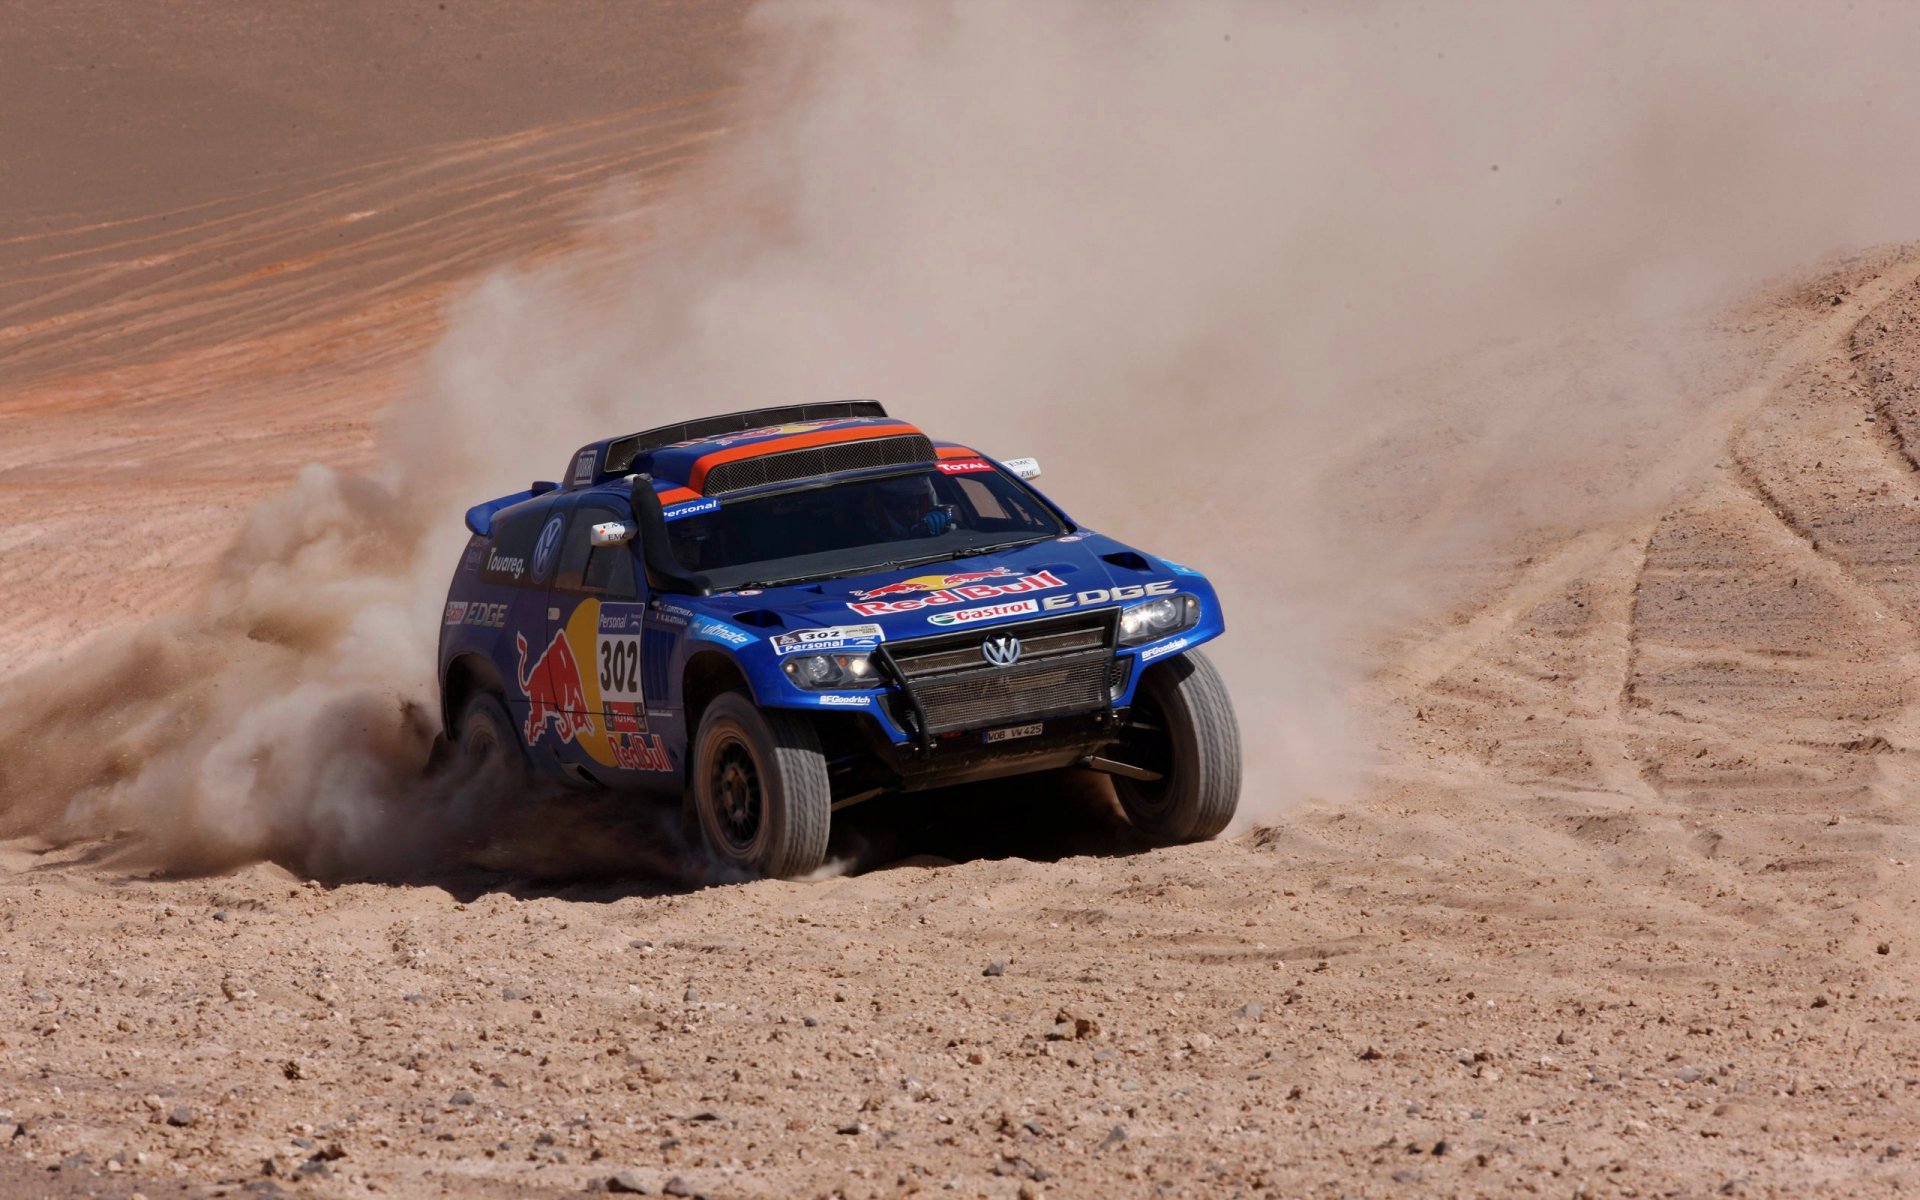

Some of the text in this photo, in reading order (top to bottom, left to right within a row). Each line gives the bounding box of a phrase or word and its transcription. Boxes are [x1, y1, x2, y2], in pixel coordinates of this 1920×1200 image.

[938, 462, 990, 471] TOTAL
[847, 570, 1068, 617] Red Bull
[1042, 580, 1179, 610] EDGE
[463, 602, 509, 628] EDGE
[955, 602, 1033, 621] Castrol
[600, 613, 627, 629] Personal
[805, 631, 840, 640] 302
[785, 639, 844, 652] Personal
[600, 640, 638, 693] 302
[819, 695, 870, 705] BFGoodrich
[1024, 725, 1042, 735] 425
[607, 733, 674, 772] Red Bull
